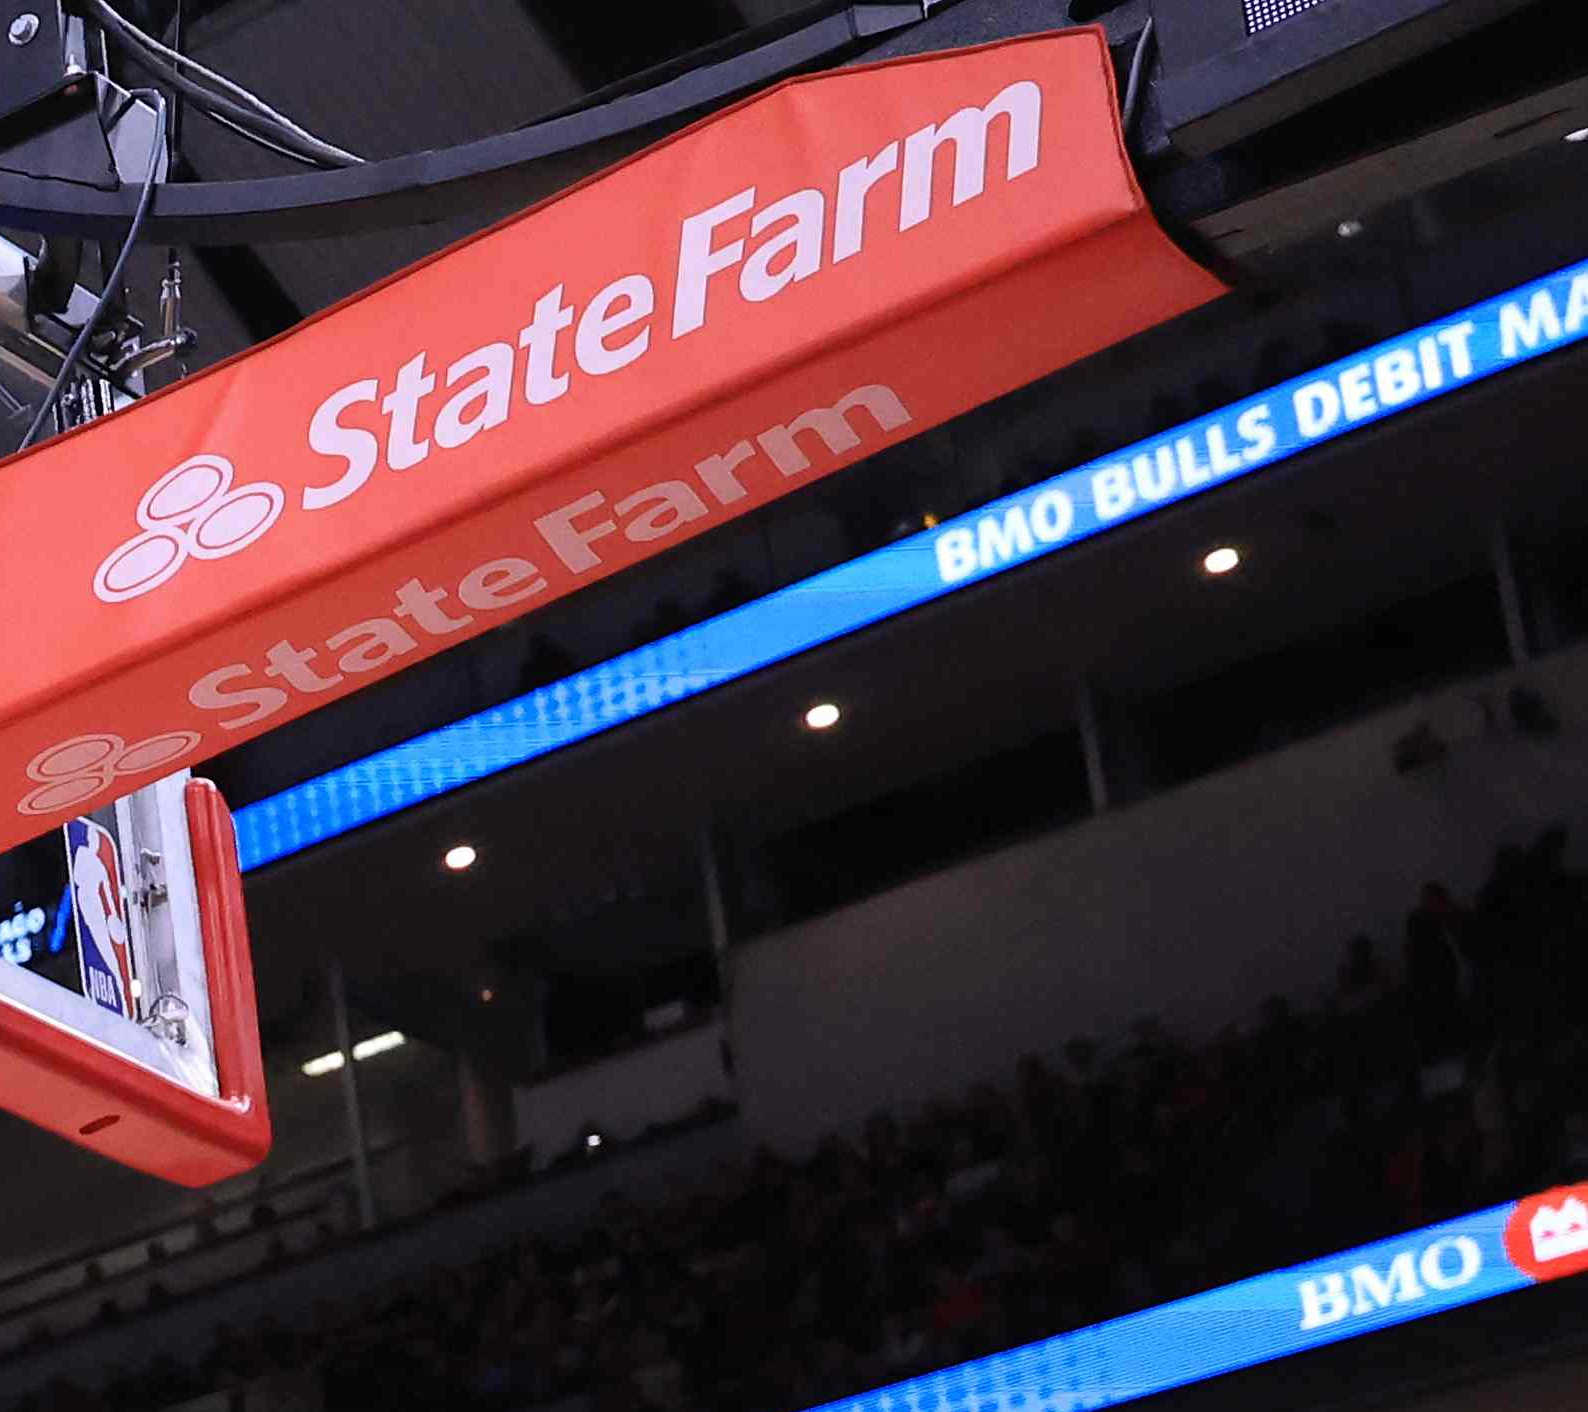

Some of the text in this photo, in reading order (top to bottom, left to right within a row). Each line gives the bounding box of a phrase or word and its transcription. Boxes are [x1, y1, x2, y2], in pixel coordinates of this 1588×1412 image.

[936, 270, 1588, 583] BMO BULLS DEBIT MA
[1300, 1236, 1482, 1331] BMO
